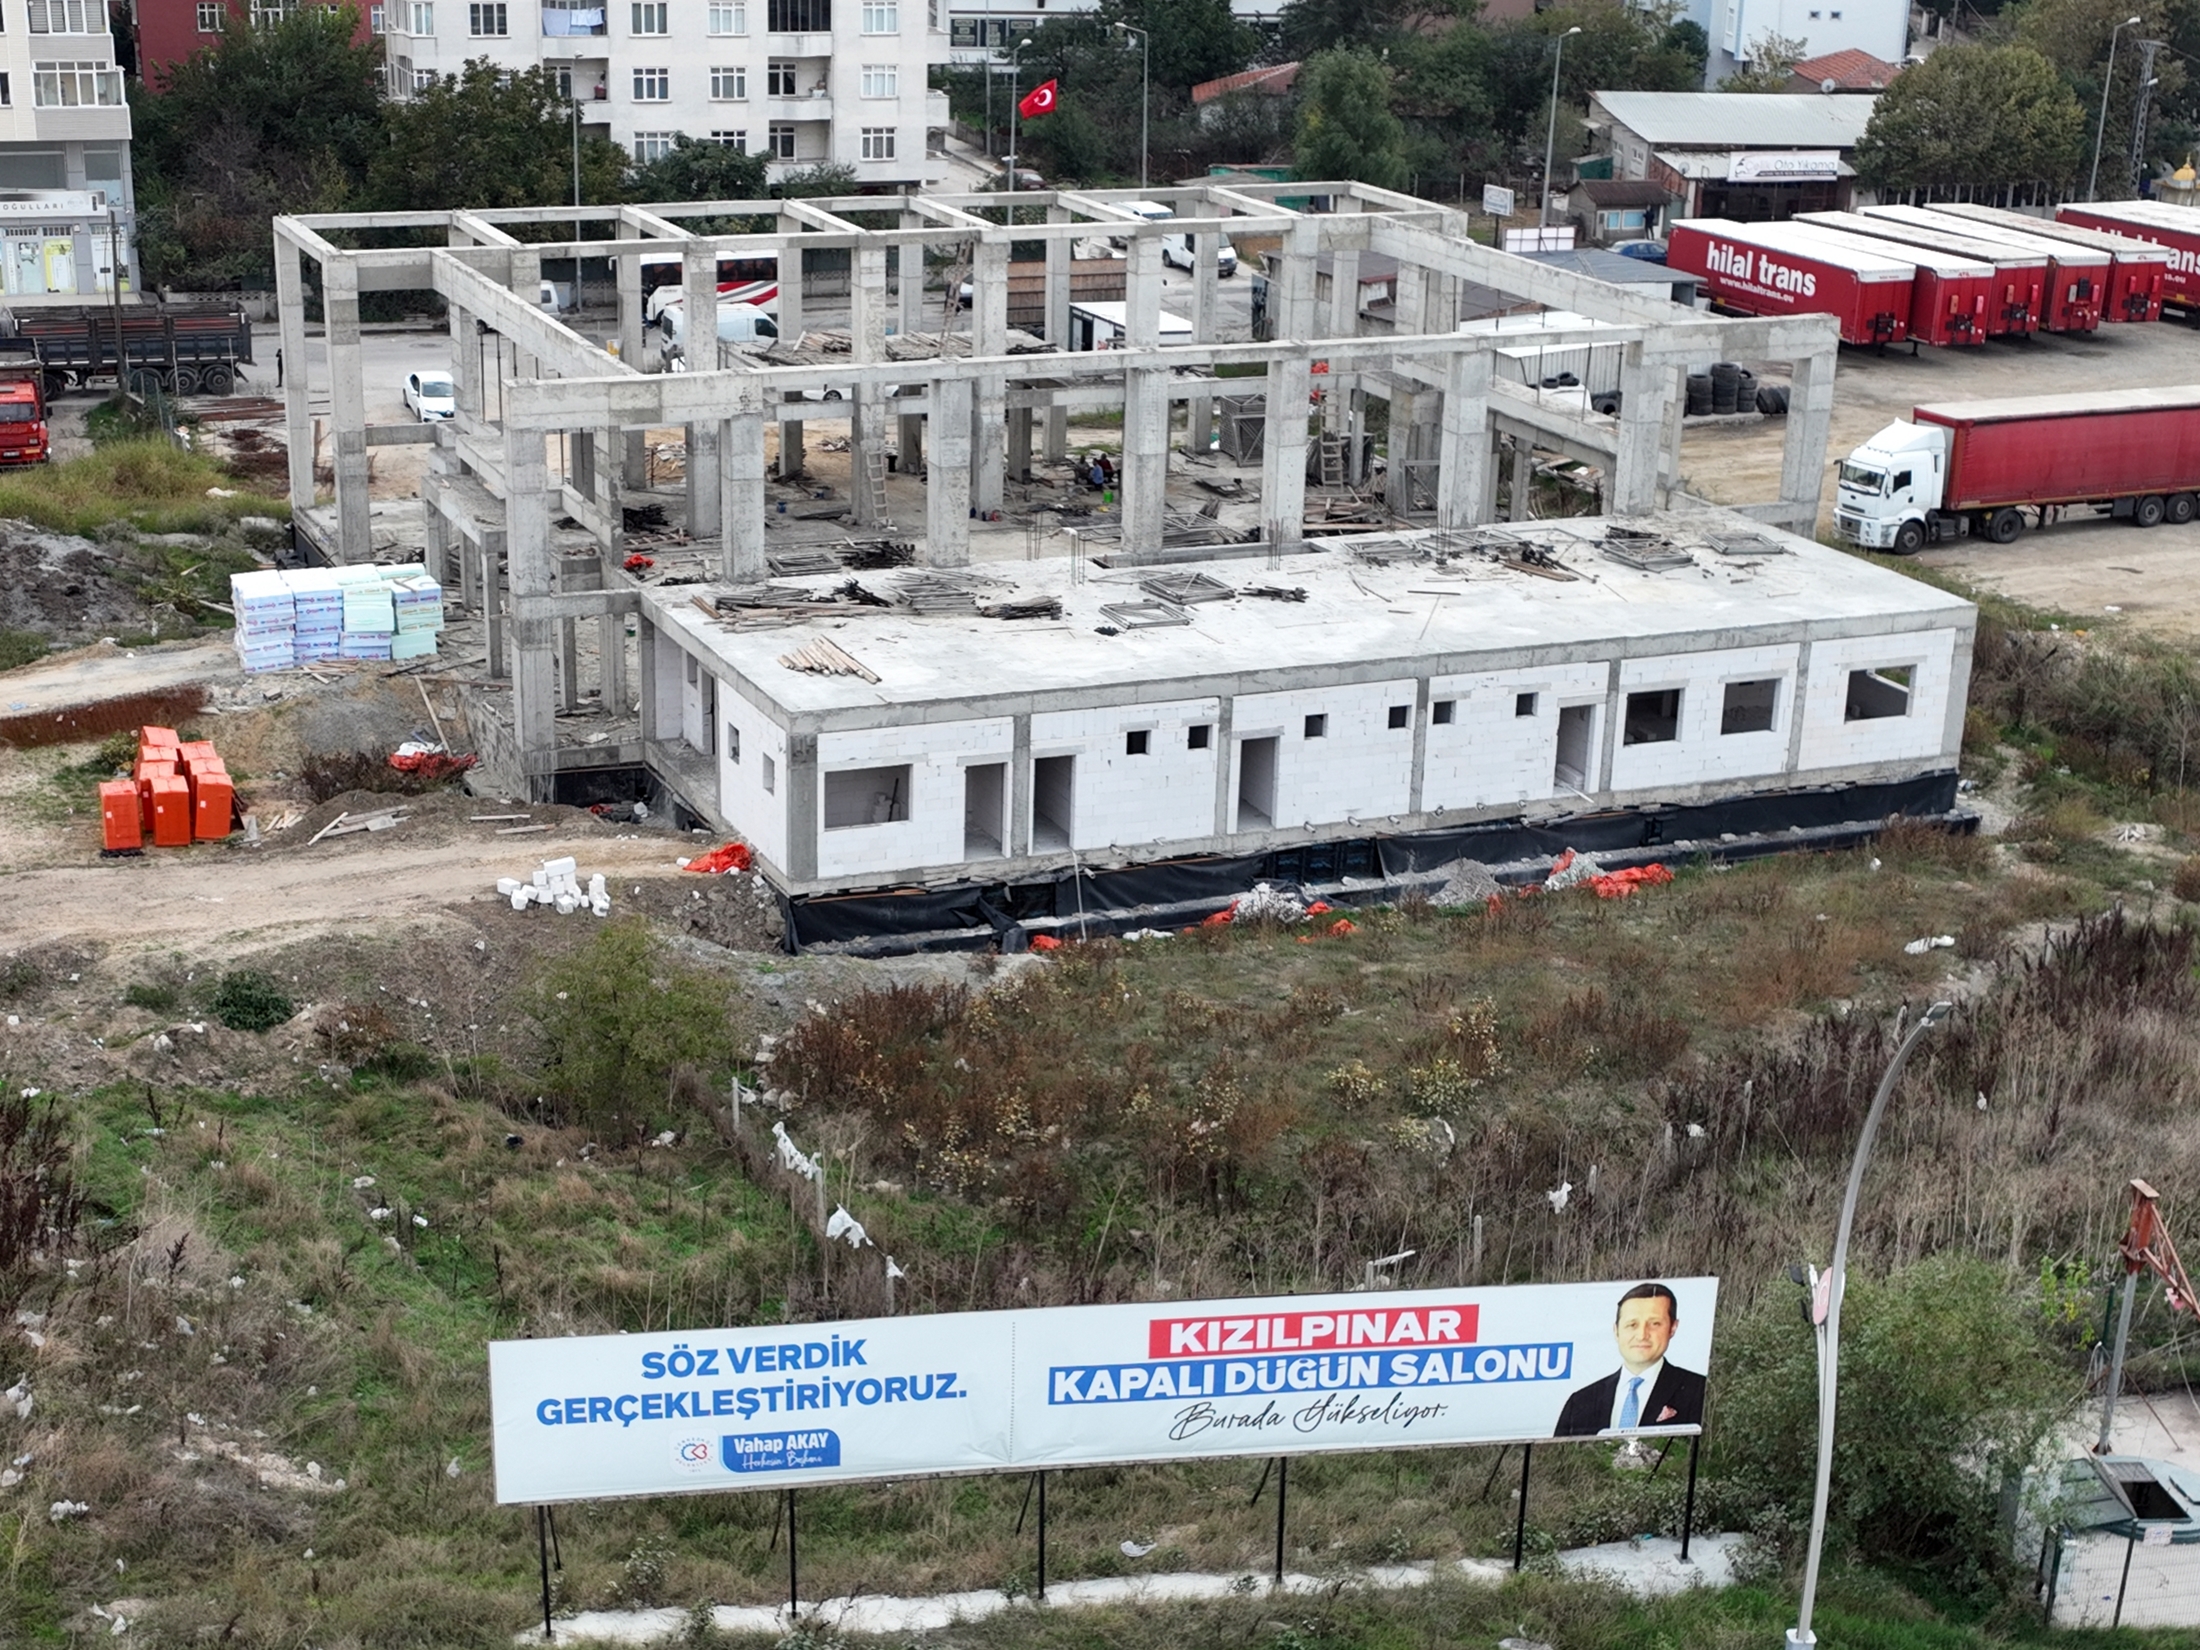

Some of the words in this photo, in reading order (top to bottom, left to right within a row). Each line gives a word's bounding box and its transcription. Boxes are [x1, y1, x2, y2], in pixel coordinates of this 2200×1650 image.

[1774, 160, 1794, 170] Oto
[1706, 240, 1754, 280] hilal
[1758, 253, 1817, 297] trans
[1719, 276, 1795, 304] www.hilaltrans.eu
[1169, 1310, 1462, 1354] KIZILPINAR
[641, 1343, 719, 1379] SÖZ
[726, 1334, 867, 1374] VERDİK
[1054, 1364, 1215, 1402] KAPALI
[1225, 1354, 1380, 1393] DÜĞÜN
[1389, 1347, 1568, 1386] SALONU
[536, 1372, 968, 1427] GERÇEKLEŞTİRİYORUZ.
[1169, 1400, 1286, 1440] Burada
[1293, 1391, 1448, 1433] Yükseliyor.
[734, 1437, 783, 1454] Vahap
[787, 1432, 829, 1450] AKAY
